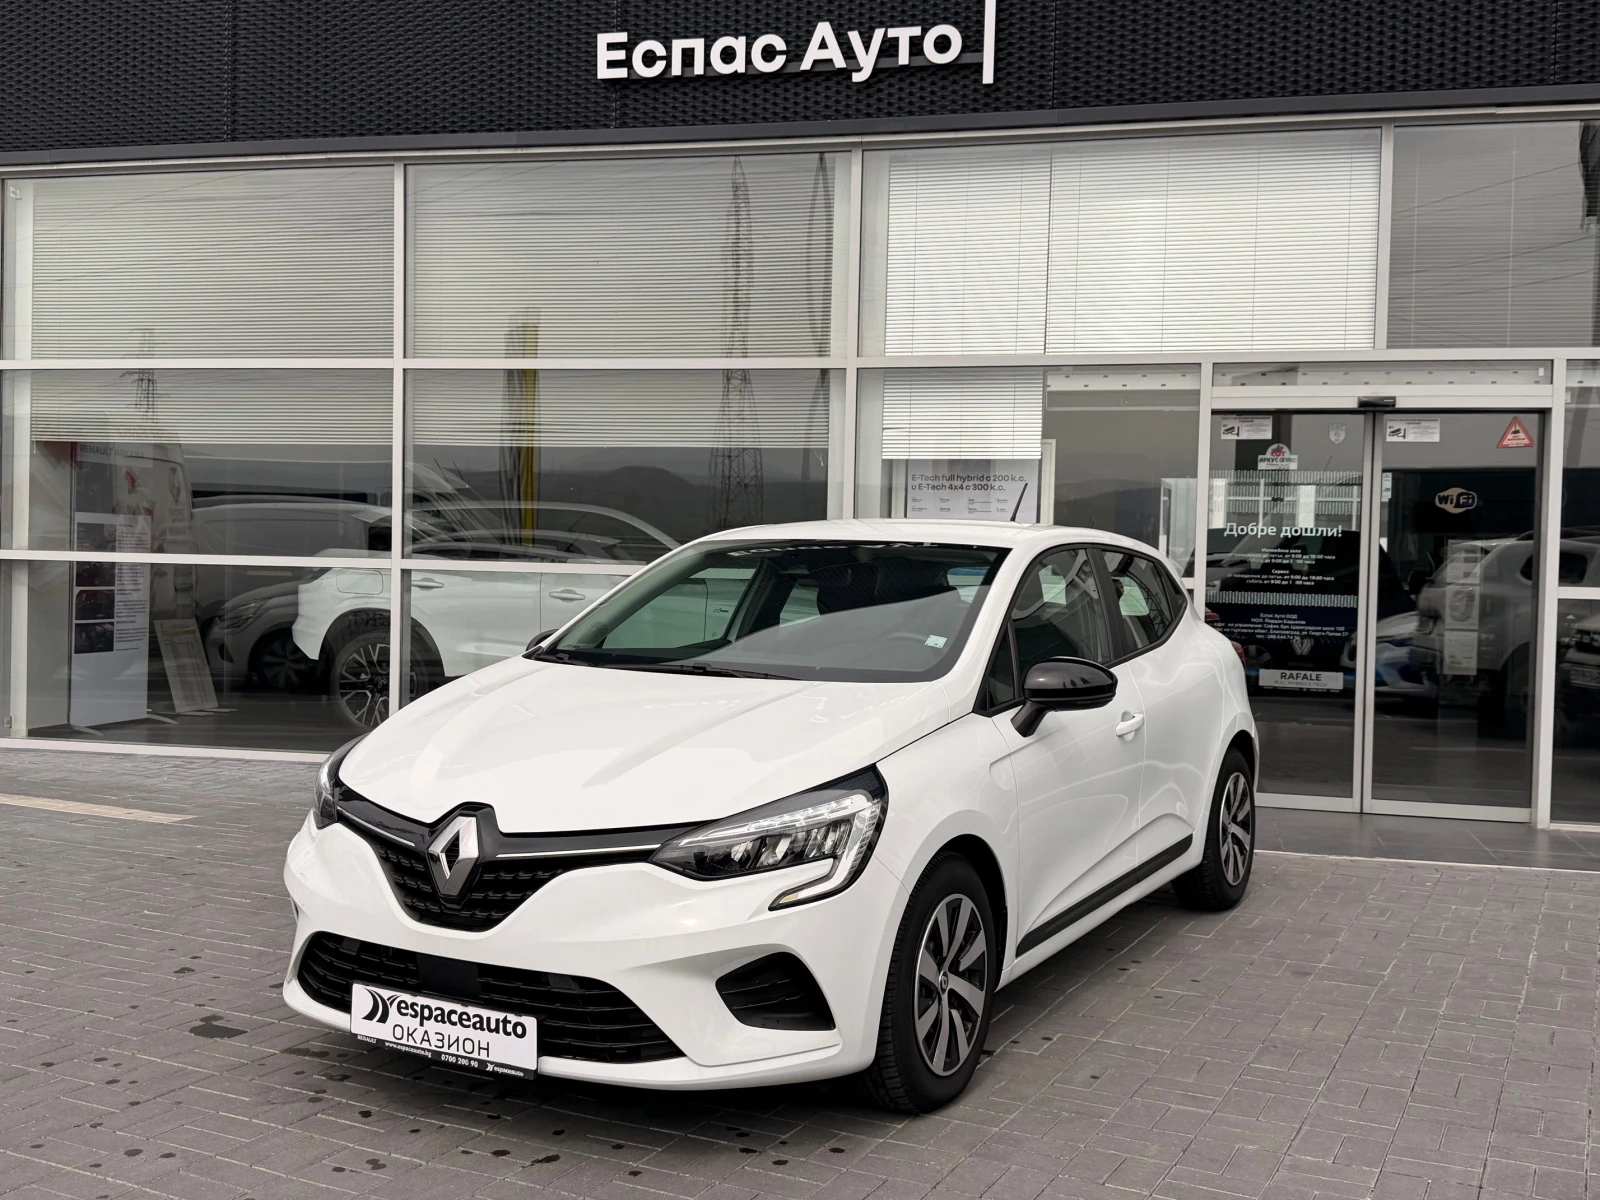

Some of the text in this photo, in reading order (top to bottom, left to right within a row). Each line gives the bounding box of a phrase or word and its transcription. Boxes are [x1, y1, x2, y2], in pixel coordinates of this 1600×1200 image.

[596, 21, 963, 83] Еспас Ауто
[79, 444, 113, 456] RENAULT
[956, 474, 984, 483] hybrid
[1224, 522, 1342, 538] Добре дошли!
[1280, 672, 1322, 681] RAFALE
[396, 999, 527, 1039] espaceauto
[392, 1024, 490, 1058] ОКАЗИОН
[357, 1034, 377, 1044] RENAULT
[384, 1041, 432, 1058] www.espaceauto.bg
[441, 1054, 456, 1063] 0700
[458, 1058, 469, 1066] 200
[493, 1066, 524, 1077] espaceauto
